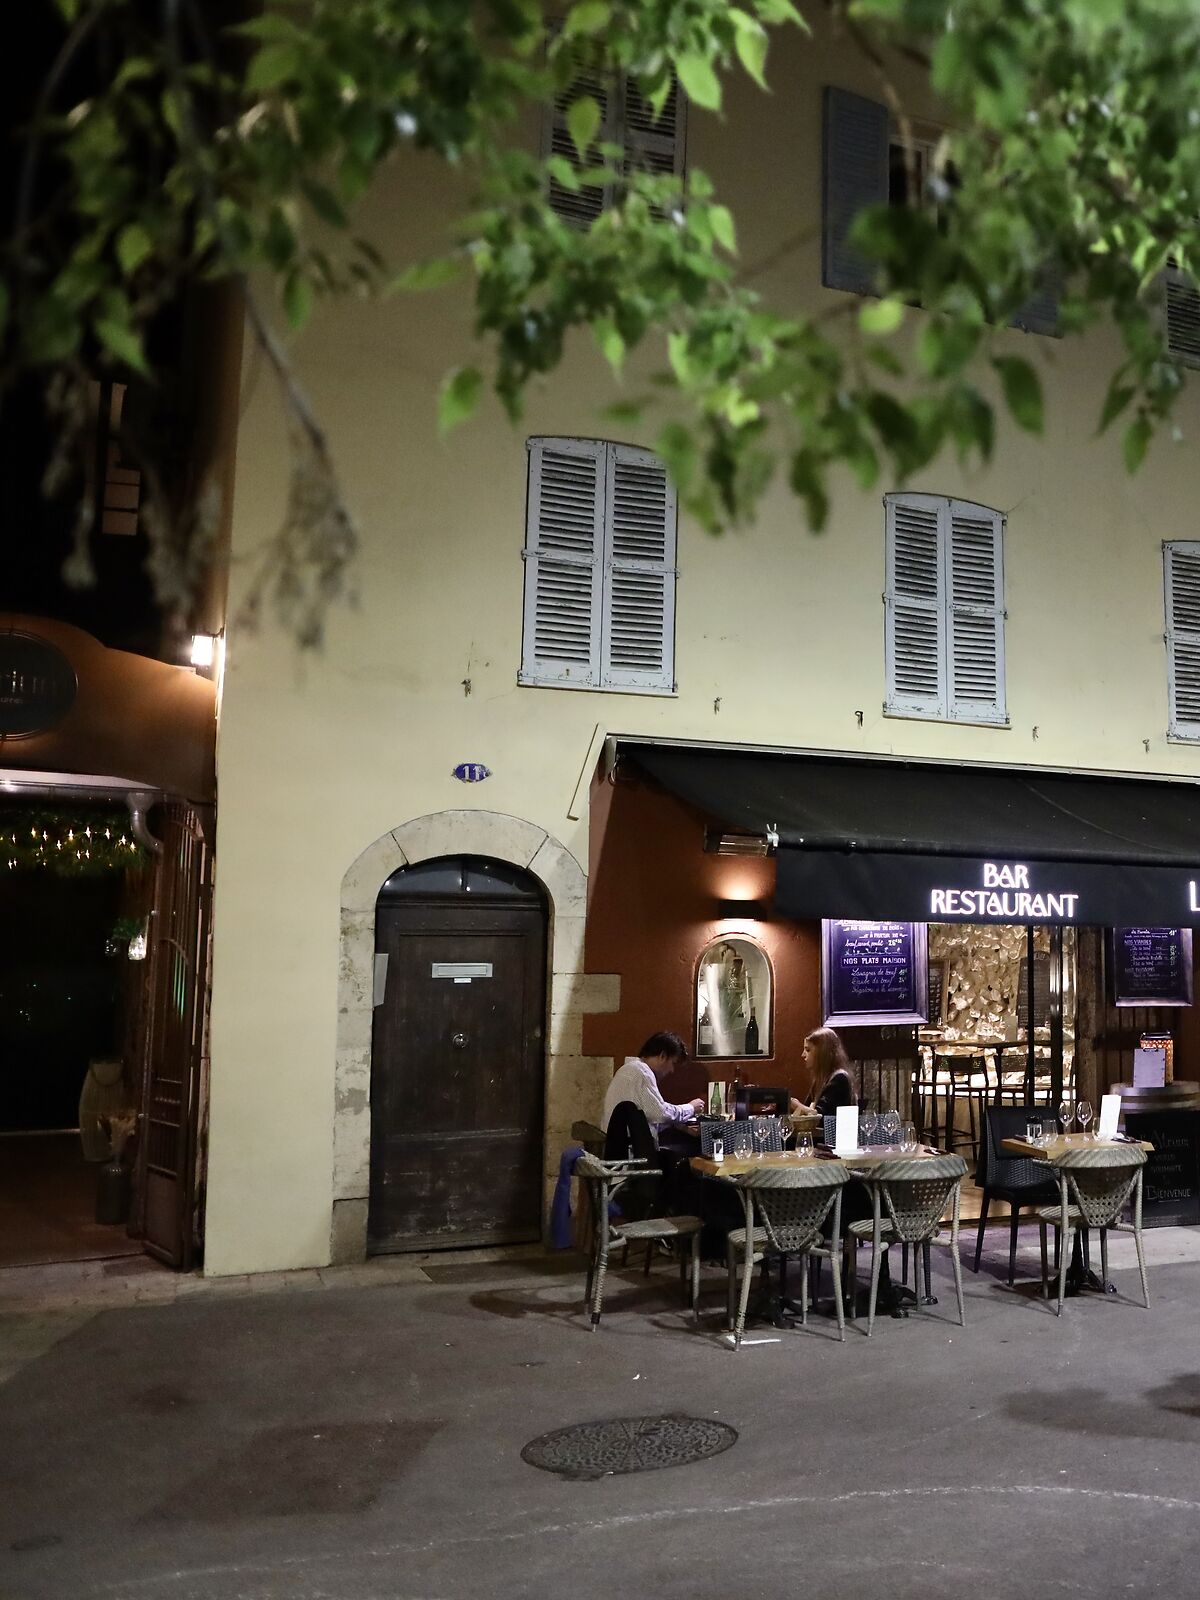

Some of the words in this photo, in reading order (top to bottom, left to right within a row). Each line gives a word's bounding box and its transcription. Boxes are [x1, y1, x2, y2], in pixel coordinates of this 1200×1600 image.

[983, 863, 1029, 889] BAR
[930, 889, 1079, 918] RESTAURANT
[861, 957, 879, 965] PLATS
